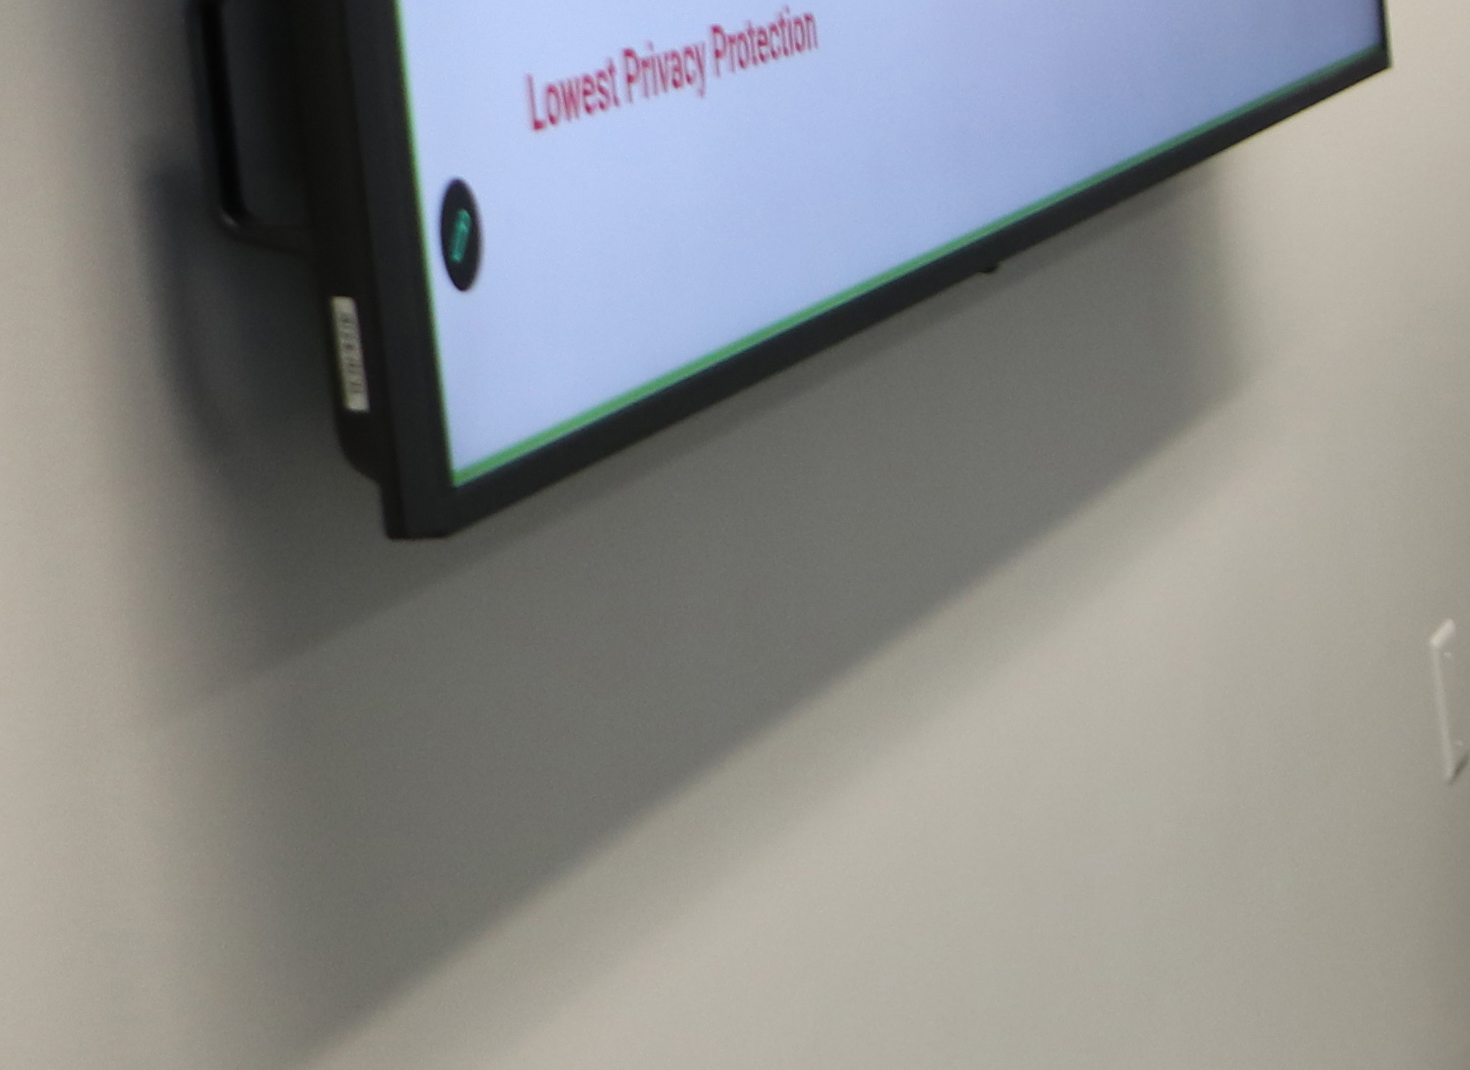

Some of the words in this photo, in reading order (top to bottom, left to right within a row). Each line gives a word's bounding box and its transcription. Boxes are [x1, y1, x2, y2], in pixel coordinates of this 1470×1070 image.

[525, 57, 621, 131] Lowest
[622, 39, 707, 103] Privacy
[710, 5, 818, 78] Protection
